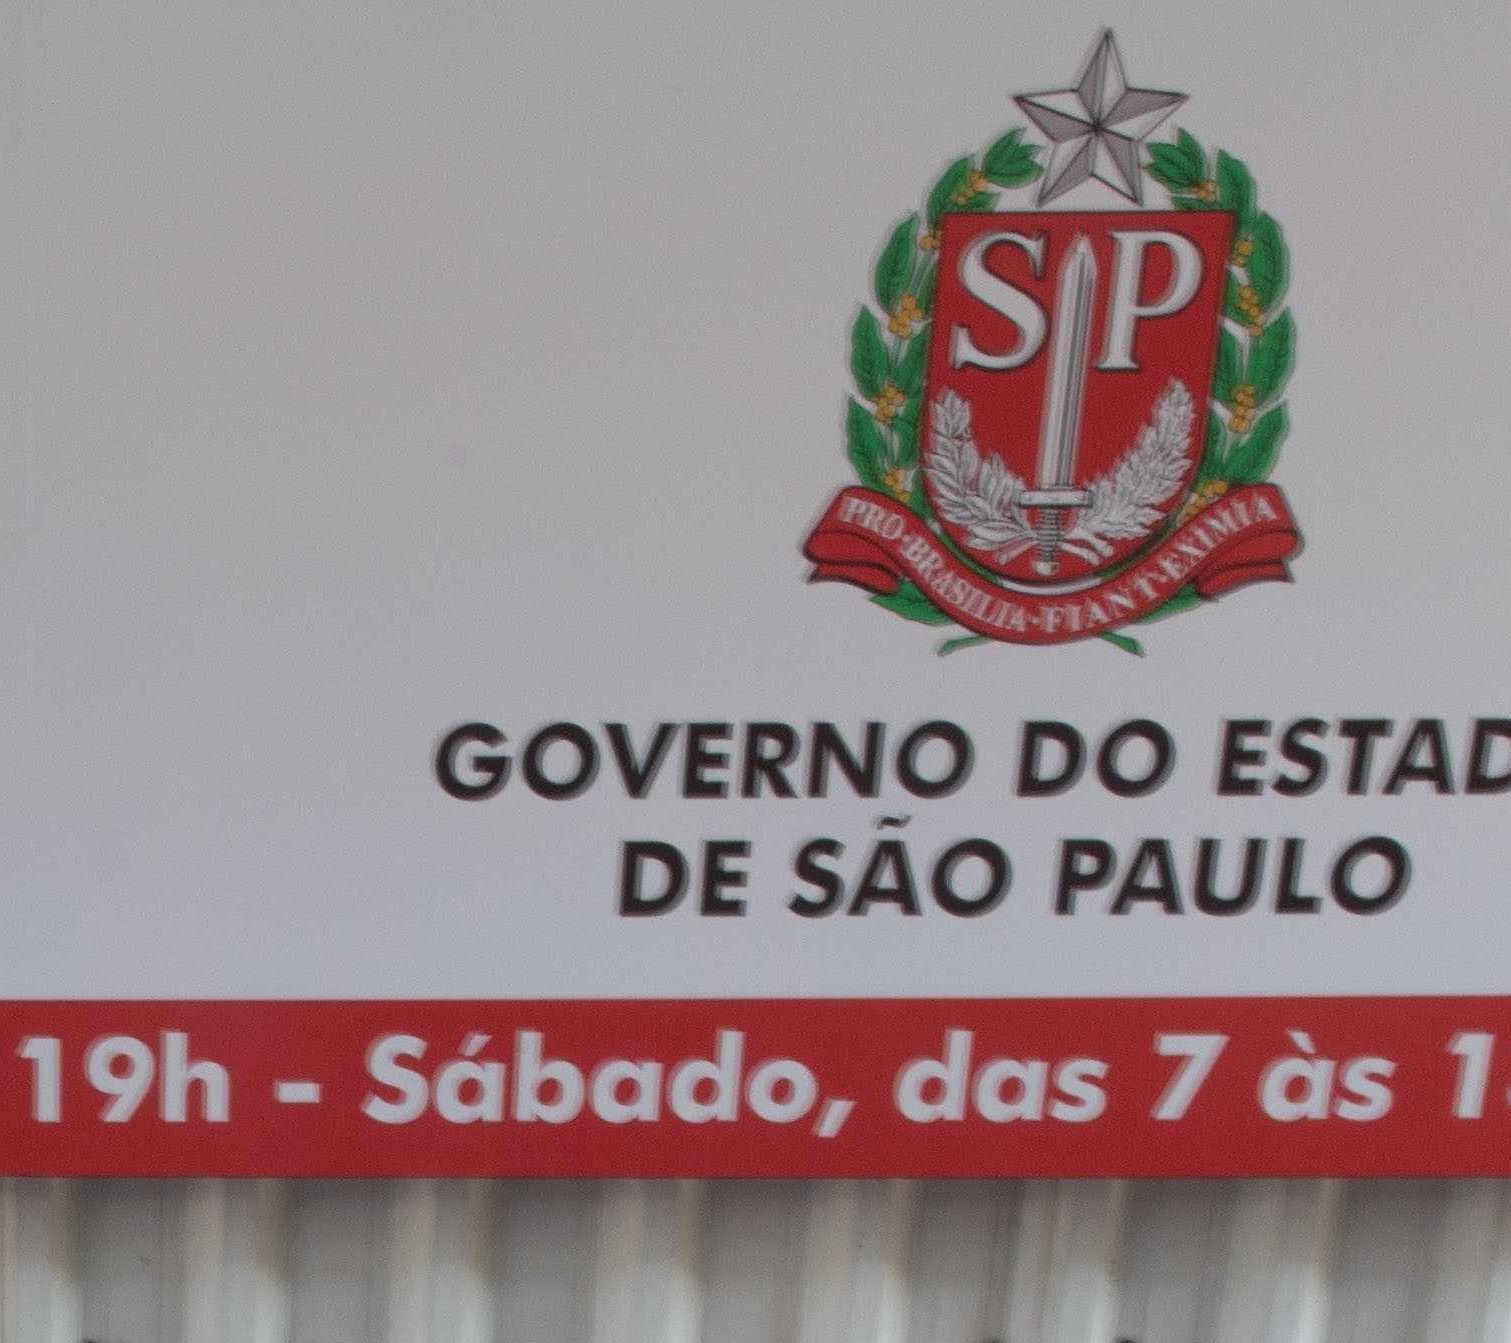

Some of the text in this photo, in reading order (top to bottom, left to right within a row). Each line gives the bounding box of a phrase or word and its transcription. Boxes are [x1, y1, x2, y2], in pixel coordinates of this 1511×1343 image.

[433, 718, 976, 803] GOVERNO
[1015, 717, 1178, 799] DO
[617, 815, 1414, 920] DE SÃO PAULO
[16, 1029, 233, 1124] 19h
[360, 1028, 858, 1139] Sábado,
[892, 1027, 1111, 1125] das
[1151, 1031, 1231, 1122] 7
[1256, 1028, 1398, 1124] às
